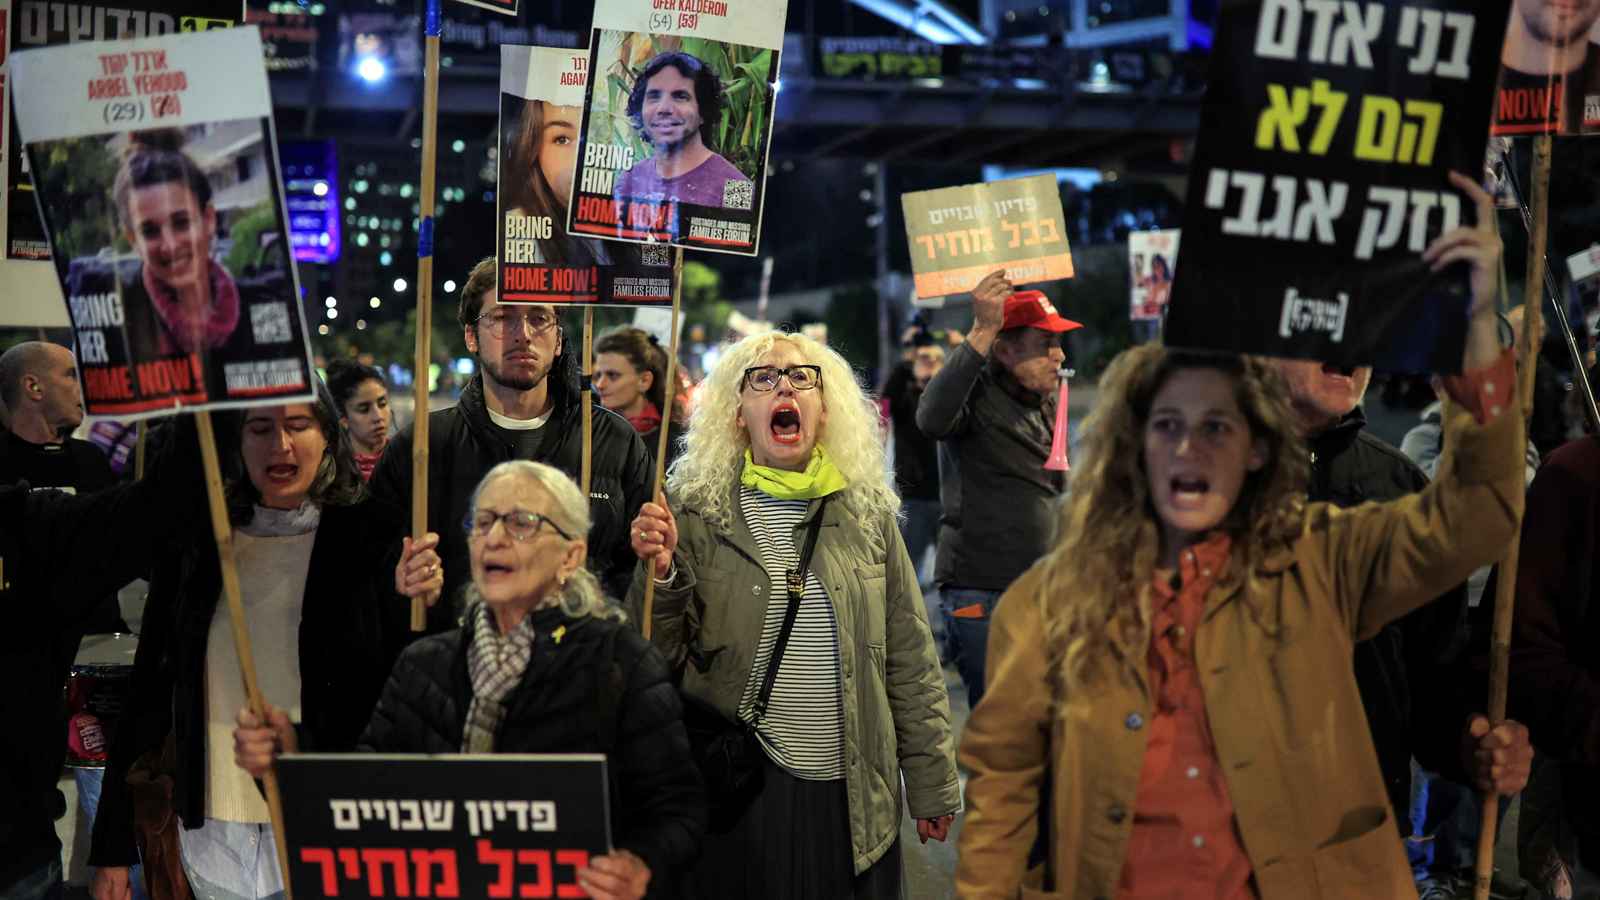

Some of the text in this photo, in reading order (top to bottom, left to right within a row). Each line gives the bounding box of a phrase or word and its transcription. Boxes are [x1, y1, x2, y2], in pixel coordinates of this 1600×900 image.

[649, 12, 672, 31] (54)
[679, 0, 726, 17] KALDERON
[1254, 0, 1474, 79] בני אדם
[88, 76, 131, 99] ARBEL
[1499, 83, 1562, 121] NOW!
[103, 101, 144, 124] (29)
[1255, 78, 1443, 165] הם לא
[585, 142, 633, 171] BRING
[580, 168, 614, 195] HIM
[576, 195, 673, 230] HOME NOW!
[993, 196, 1038, 219] פדיון
[1205, 168, 1349, 244] אגבי
[504, 215, 553, 240] BRING
[689, 225, 750, 244] FAMILIES FORUM
[915, 217, 1061, 260] בכל מחיר
[504, 239, 535, 264] HER
[504, 266, 599, 292] HOME NOW!
[613, 285, 670, 297] FAMILIES FORUM
[69, 291, 125, 329] BRING
[77, 329, 110, 364] HER
[83, 365, 134, 401] HOME
[136, 352, 205, 396] NOW!
[329, 798, 558, 836] פדיון שבויים
[300, 847, 460, 898] מחיר
